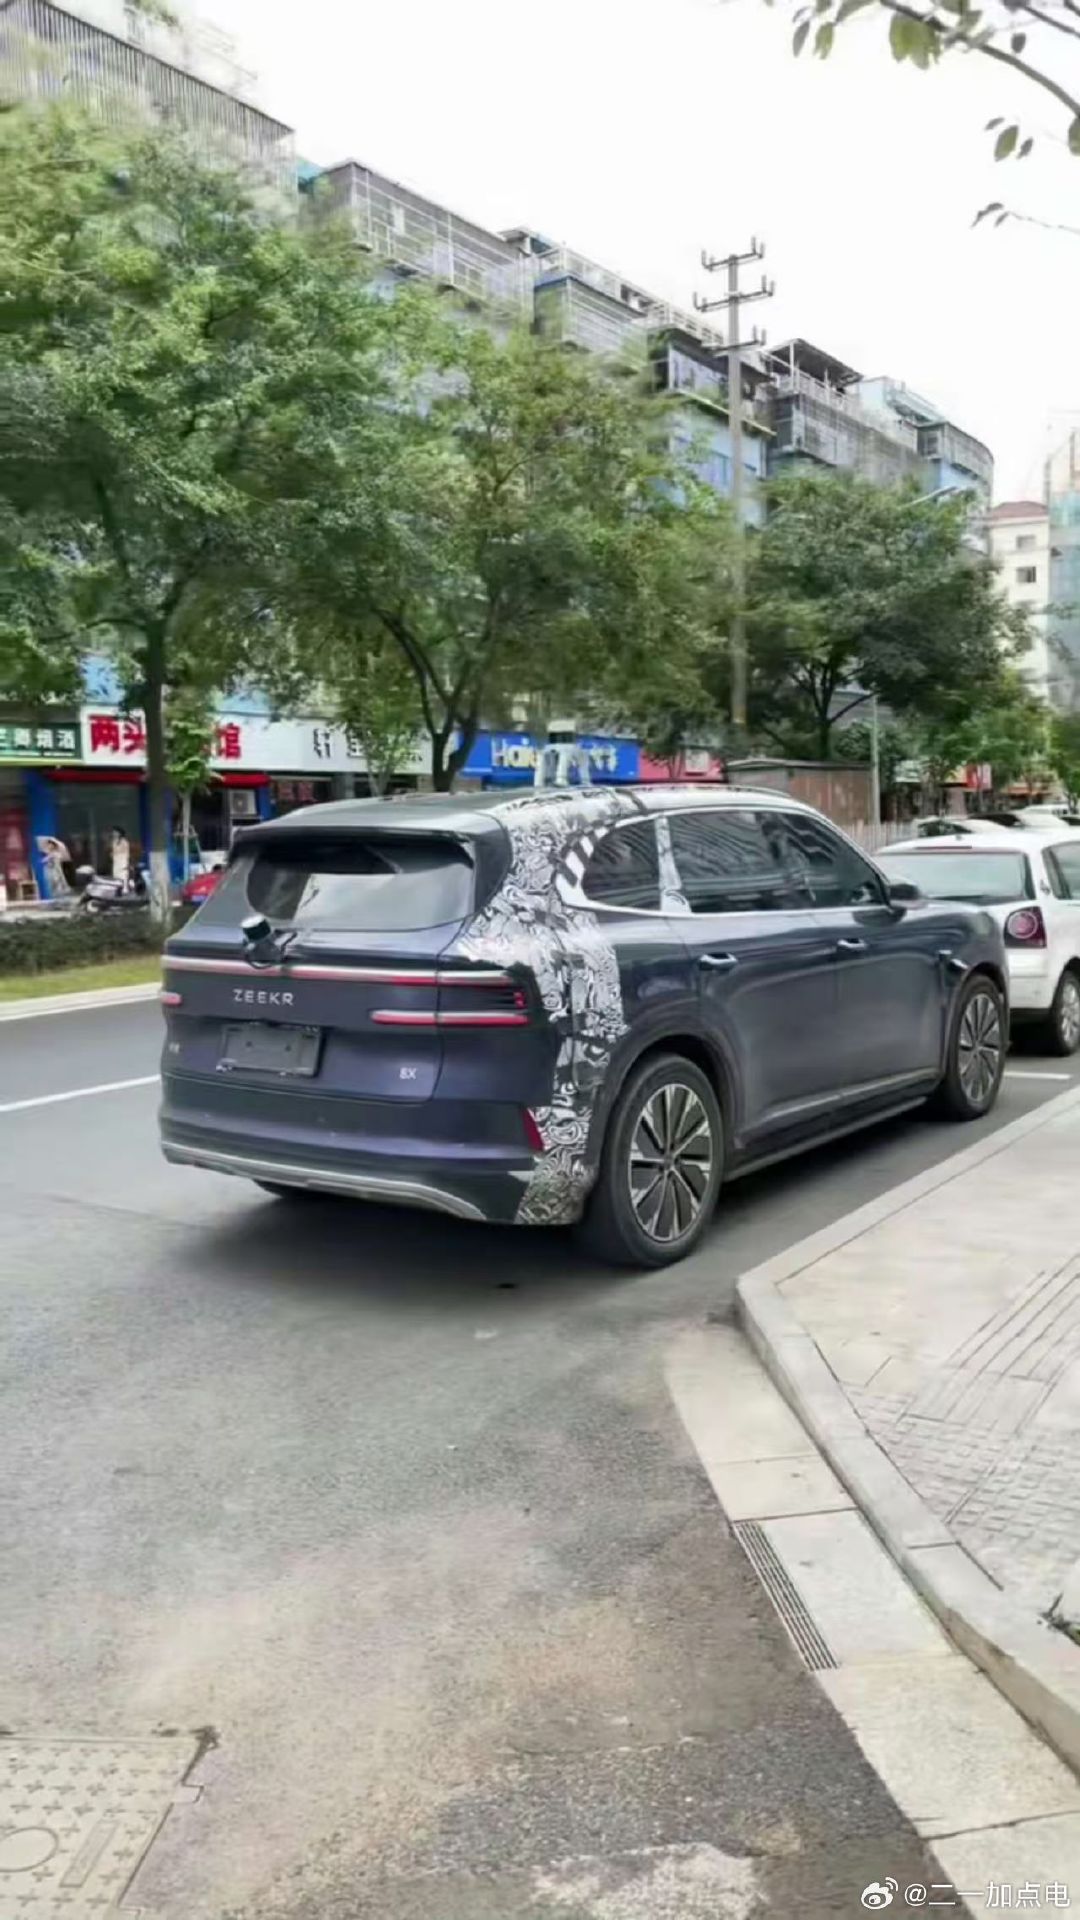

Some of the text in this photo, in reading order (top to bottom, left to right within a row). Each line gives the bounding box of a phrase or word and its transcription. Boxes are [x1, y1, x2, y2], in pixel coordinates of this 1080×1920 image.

[88, 713, 241, 759] 两头馆
[232, 988, 294, 1006] ZEEKR
